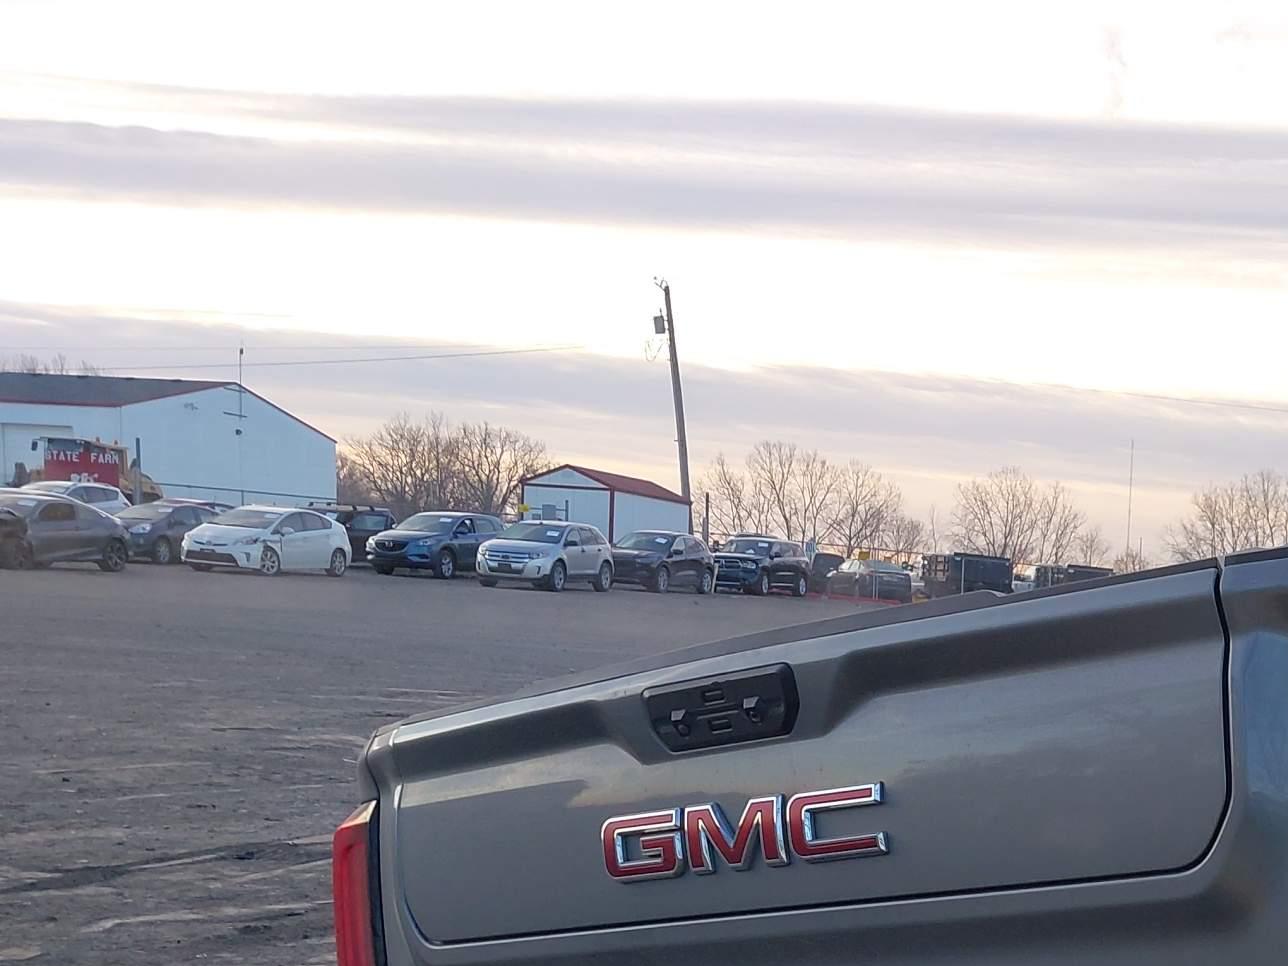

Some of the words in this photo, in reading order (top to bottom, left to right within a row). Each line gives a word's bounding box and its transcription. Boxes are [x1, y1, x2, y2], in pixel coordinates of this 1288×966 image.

[46, 450, 80, 462] STATE
[90, 452, 119, 464] FARM
[601, 780, 889, 884] GMC
